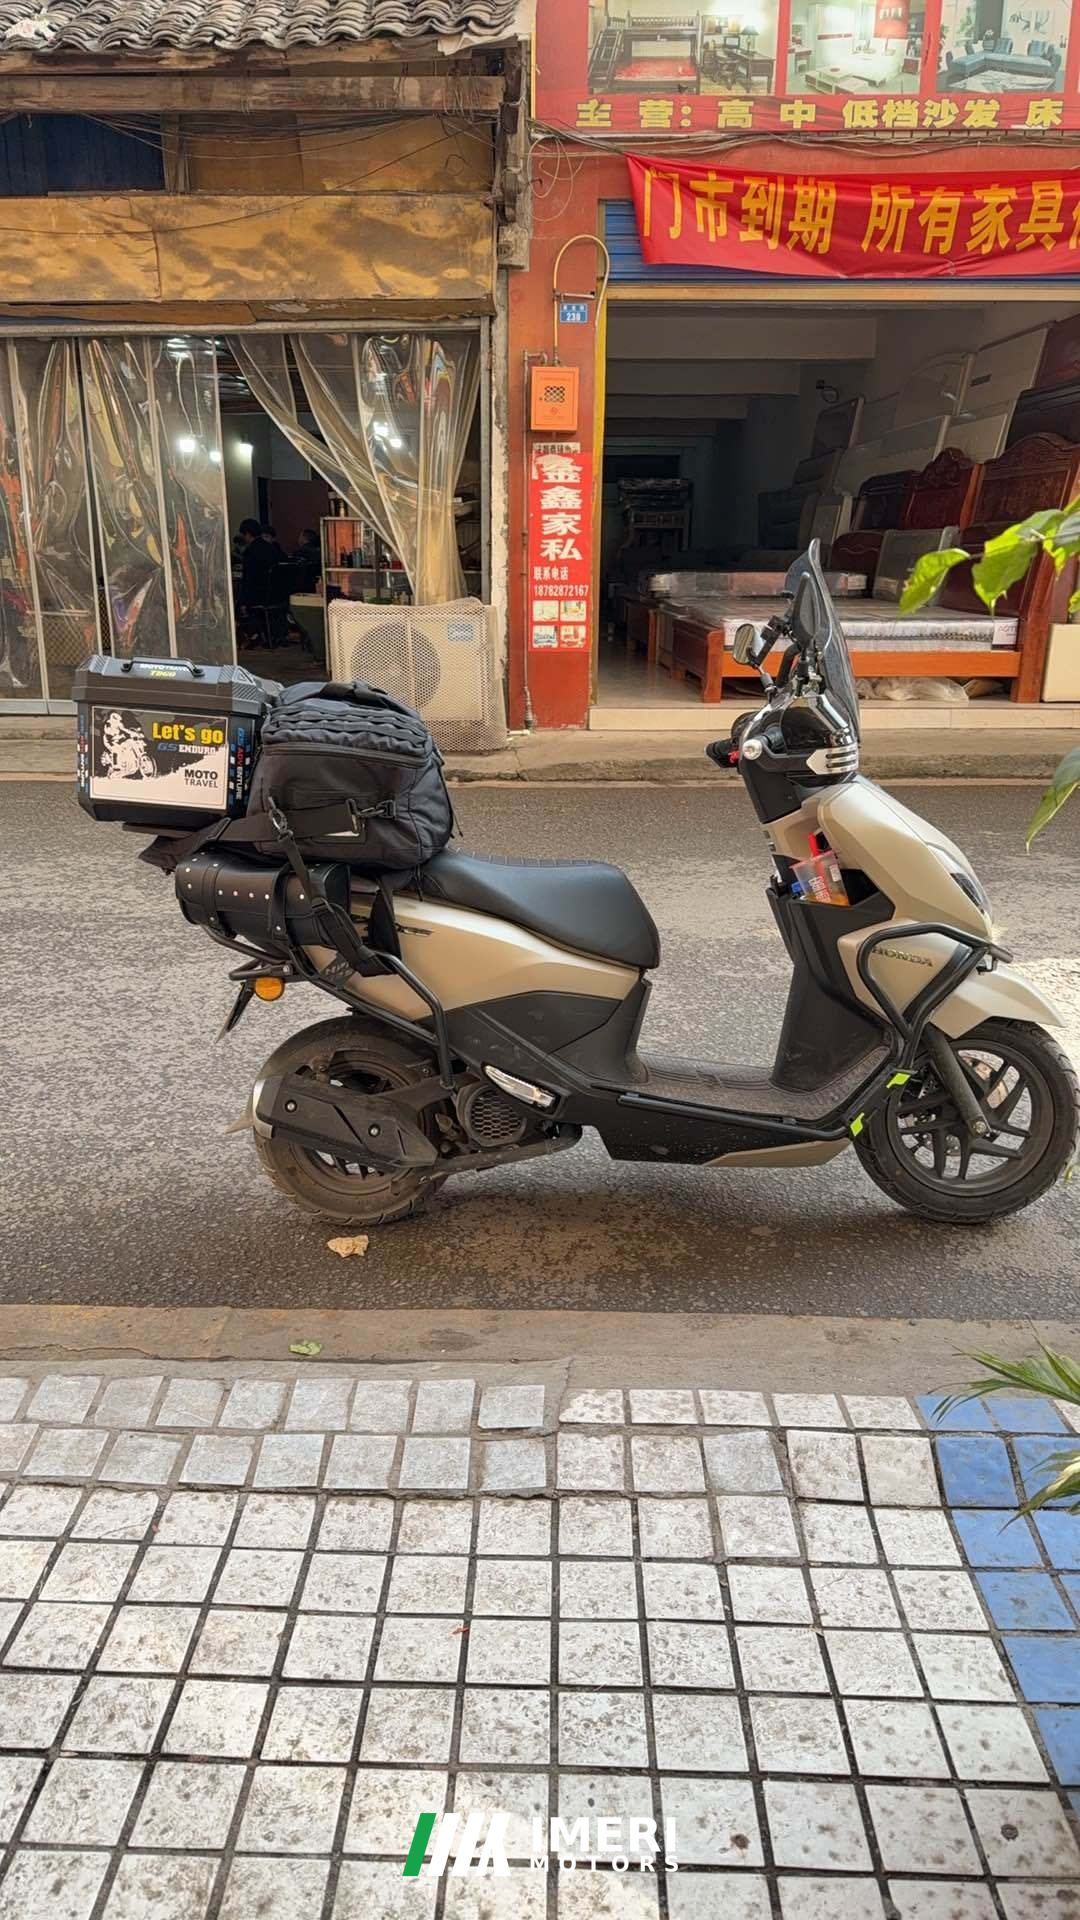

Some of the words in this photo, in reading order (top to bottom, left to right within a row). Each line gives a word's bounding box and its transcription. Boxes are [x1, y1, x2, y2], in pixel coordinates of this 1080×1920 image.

[643, 167, 837, 254] 门市到期
[533, 566, 569, 581] 联系电话
[533, 584, 589, 597] 18782872167
[152, 722, 196, 741] Let's
[200, 731, 224, 745] go
[157, 742, 178, 753] GS
[184, 769, 218, 780] MOTO
[236, 747, 244, 800] ADVENTURE
[184, 778, 218, 789] TRAVEL
[872, 946, 933, 967] HONDA
